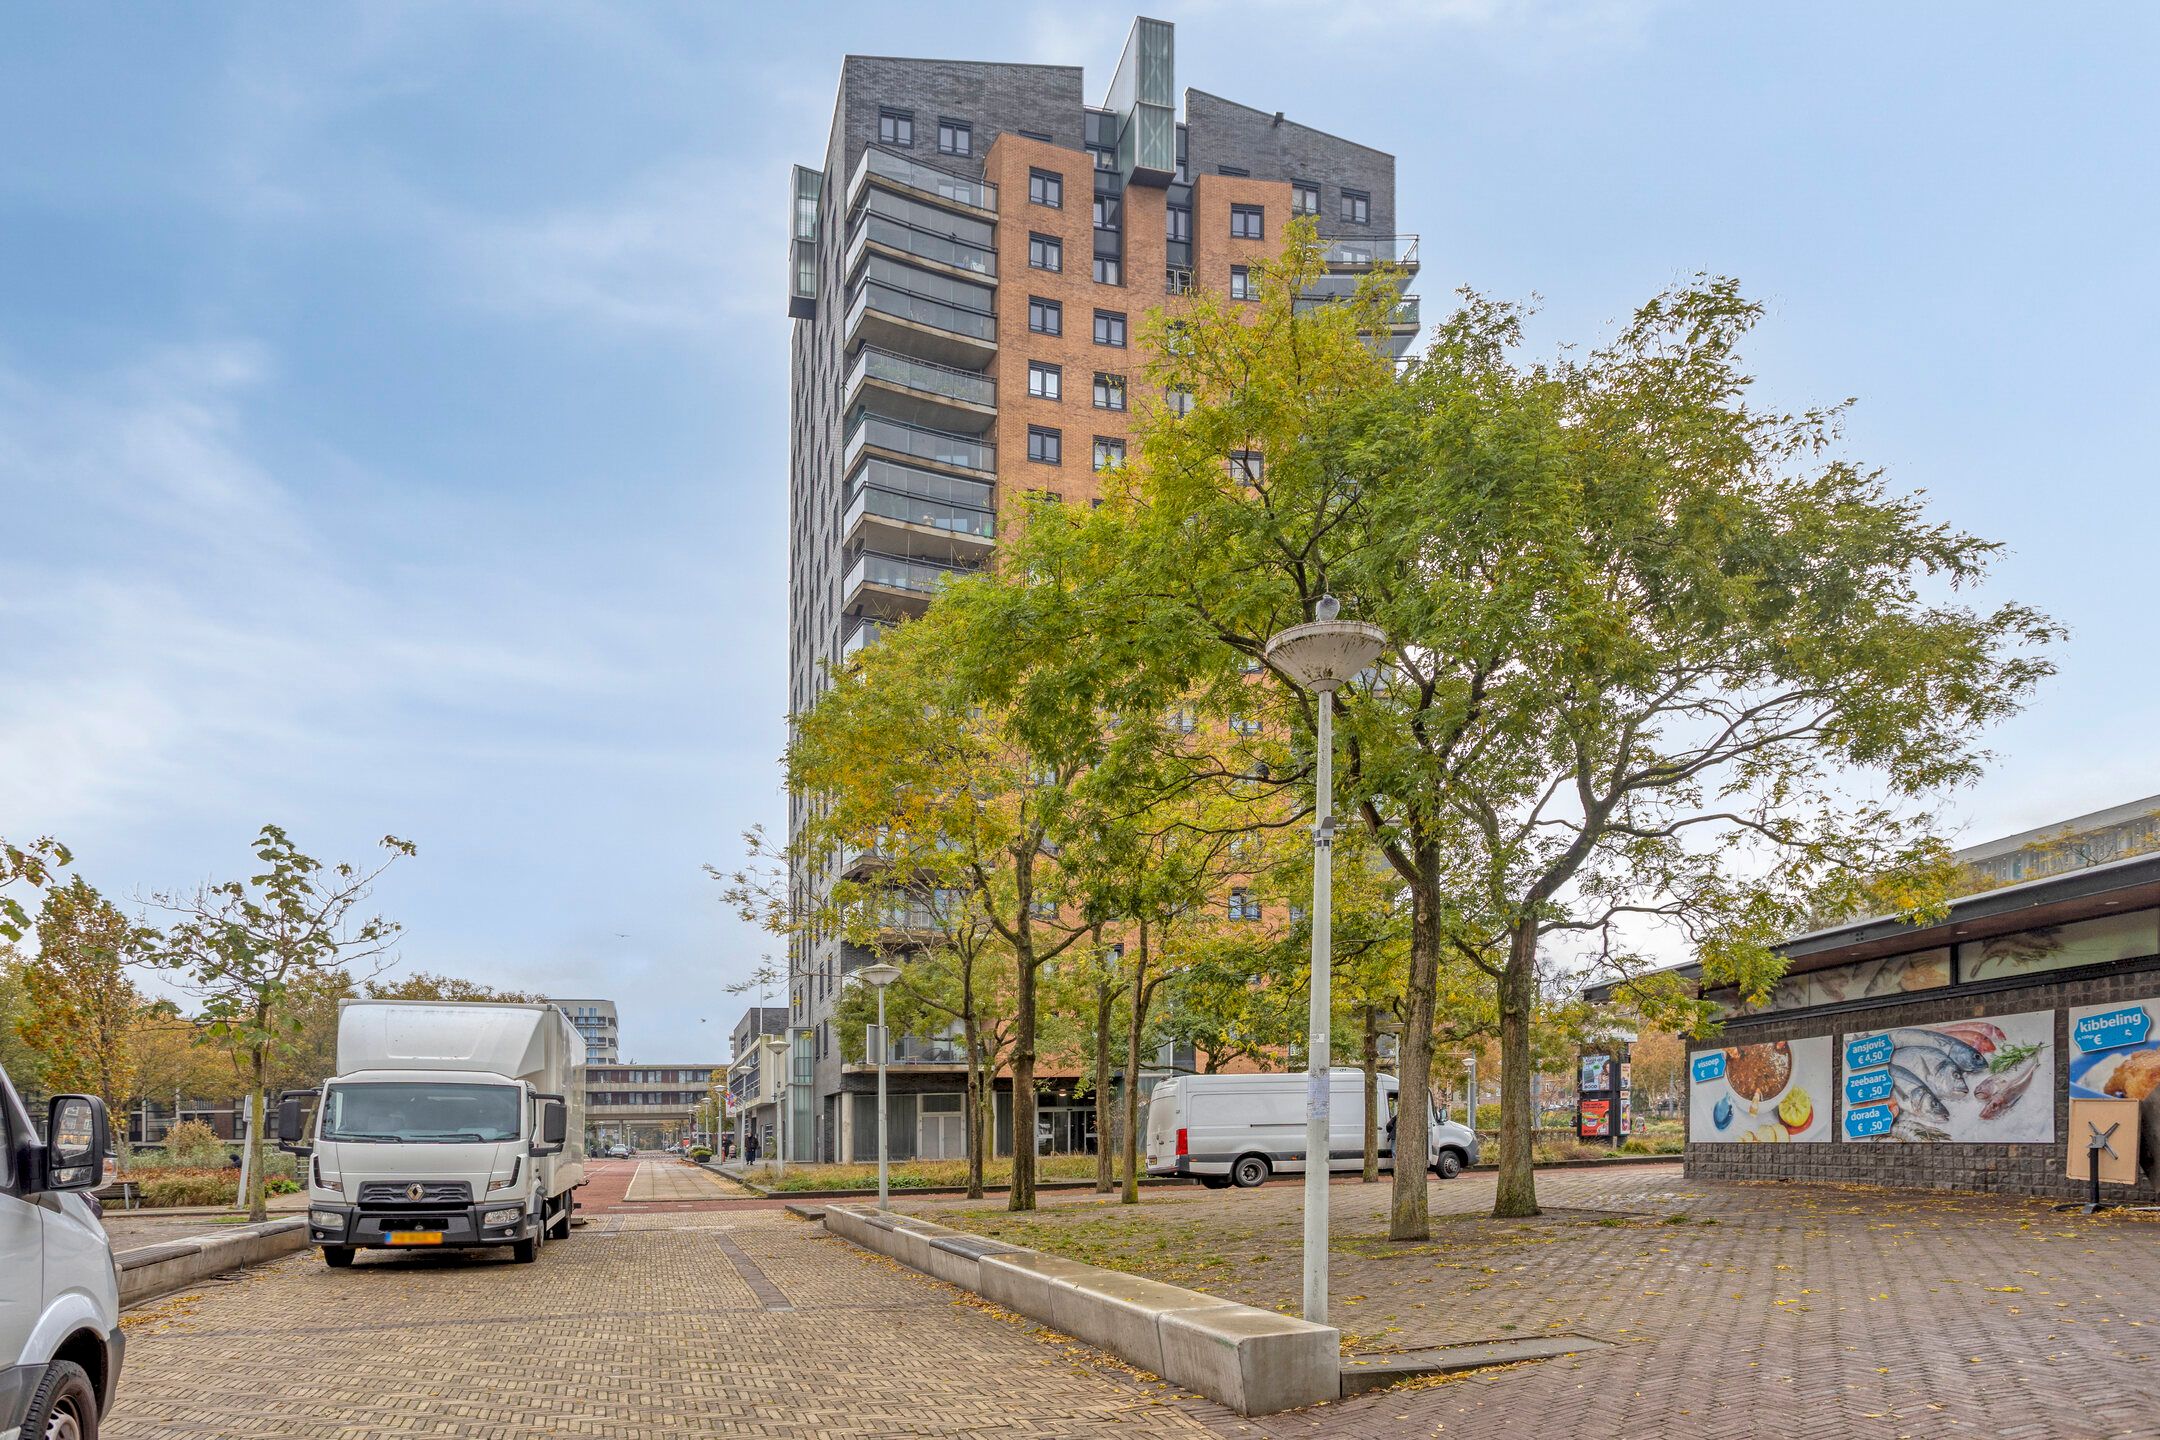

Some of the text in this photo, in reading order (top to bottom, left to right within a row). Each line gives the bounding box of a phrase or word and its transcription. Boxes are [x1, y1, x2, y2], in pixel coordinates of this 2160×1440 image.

[2080, 1013, 2141, 1032] kibbeling
[1852, 1039, 1886, 1054] ansjovis
[2093, 1034, 2103, 1045] €
[1850, 1074, 1887, 1088] zeebaars
[1850, 1108, 1880, 1121] dorada
